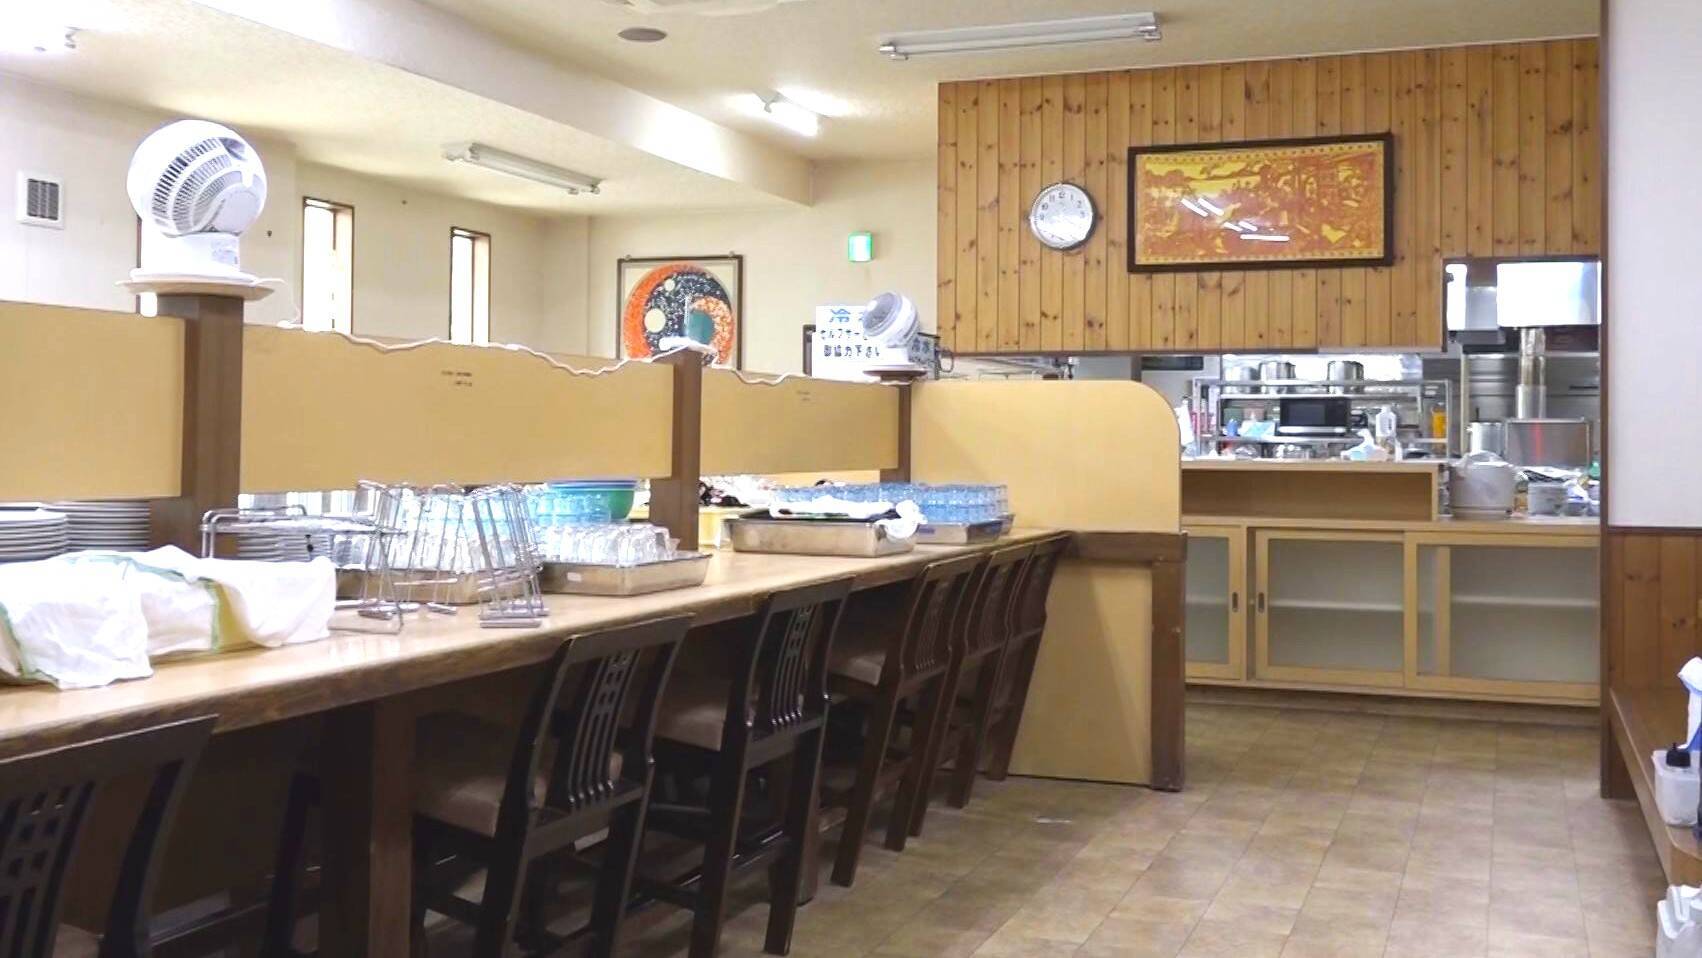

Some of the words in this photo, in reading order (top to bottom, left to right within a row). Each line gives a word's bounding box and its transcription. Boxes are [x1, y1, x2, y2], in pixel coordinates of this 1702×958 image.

[823, 344, 881, 359] 御協力下さい
